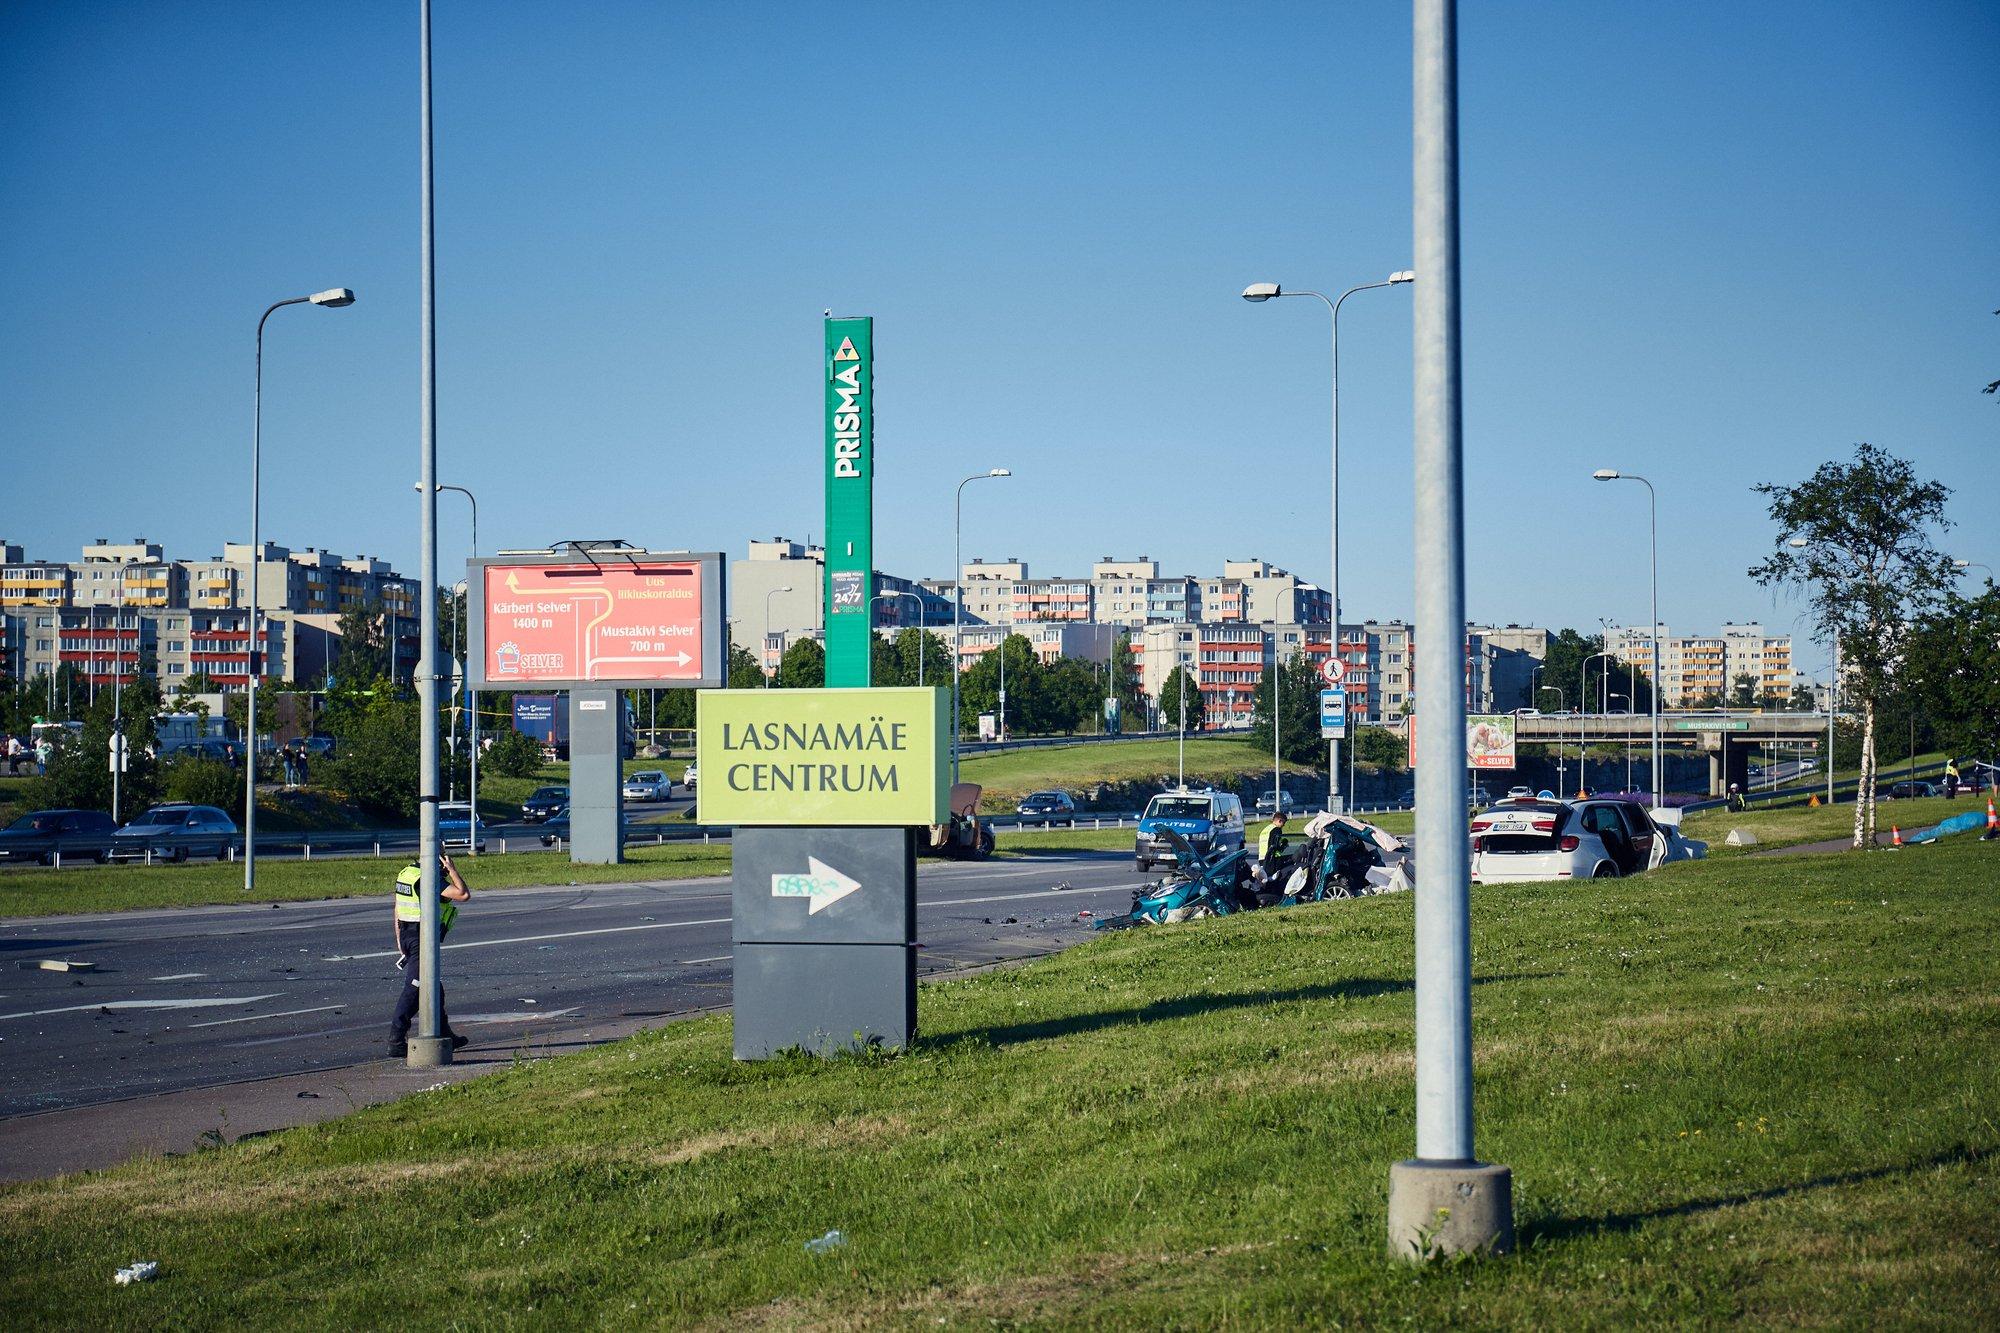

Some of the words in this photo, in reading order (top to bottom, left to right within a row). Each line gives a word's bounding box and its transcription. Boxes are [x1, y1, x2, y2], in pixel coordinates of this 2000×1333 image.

[834, 363, 861, 478] PRISMA
[645, 577, 665, 586] Uus
[618, 589, 693, 599] liikluskorraldus
[493, 602, 534, 614] Kärberi
[537, 602, 571, 613] Selver
[512, 618, 538, 628] 1400
[541, 620, 552, 628] m
[601, 626, 656, 636] Mustakivi
[659, 625, 695, 636] Selver
[630, 641, 650, 651] 700
[654, 643, 665, 651] m
[520, 653, 564, 668] SELVER
[723, 716, 906, 751] LASNAMÄE
[1480, 757, 1511, 765] e-SELVER
[727, 763, 899, 792] CENTRUM
